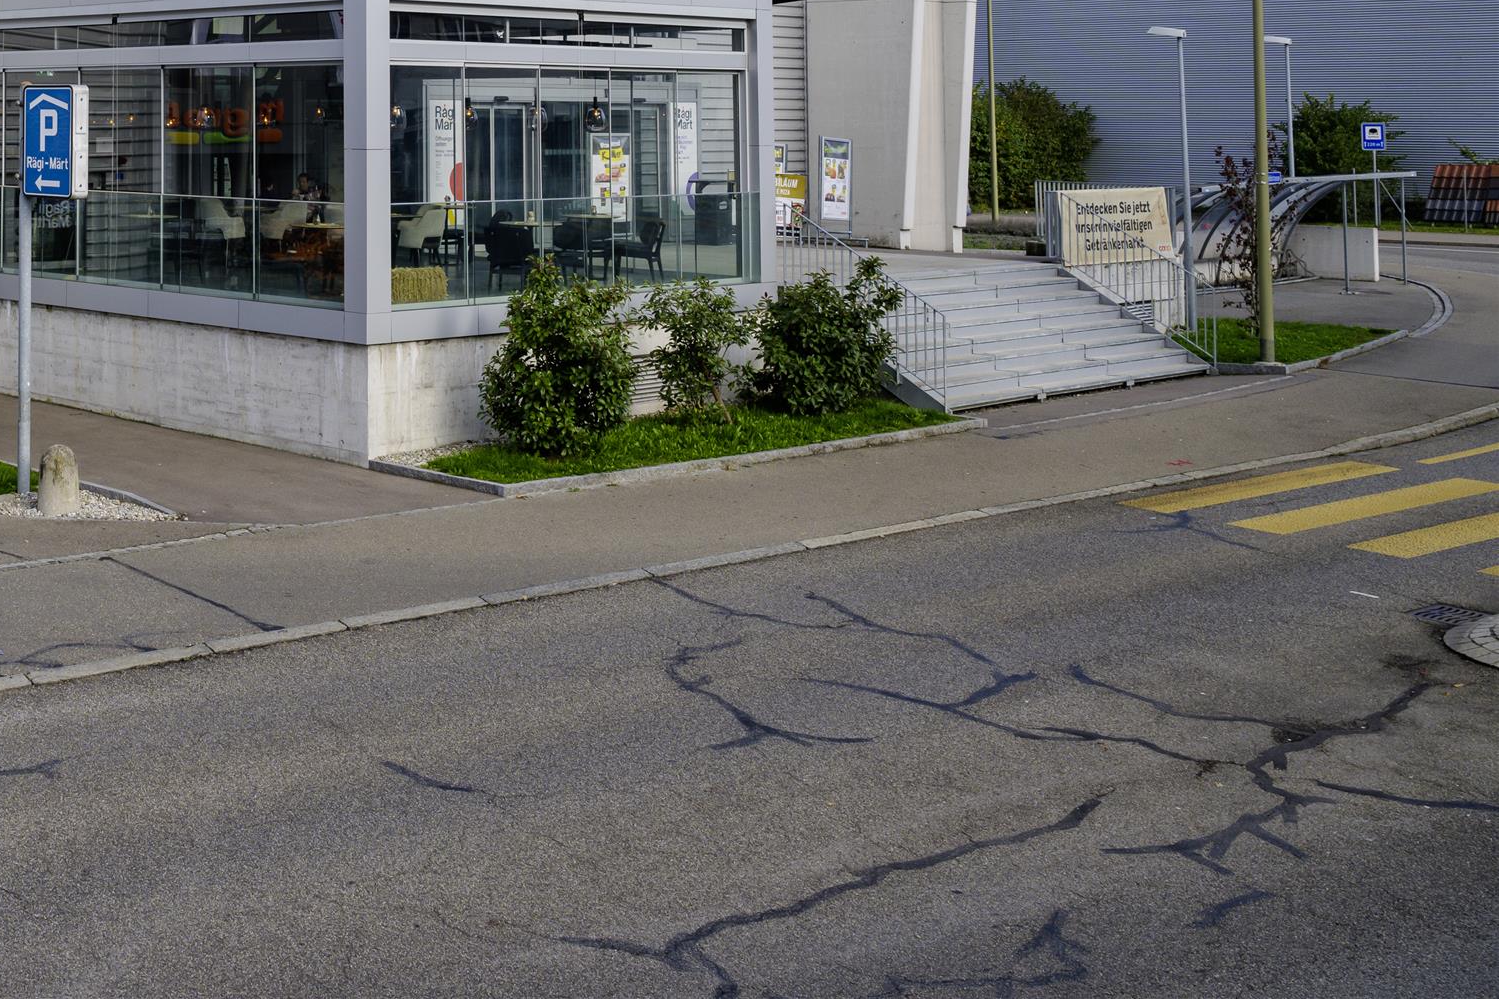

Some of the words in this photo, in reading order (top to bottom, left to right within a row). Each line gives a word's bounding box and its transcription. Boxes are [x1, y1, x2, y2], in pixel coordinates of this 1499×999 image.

[39, 108, 59, 152] P
[1076, 202, 1118, 215] Entdecken
[1119, 201, 1131, 214] Sie
[1132, 200, 1151, 216] jetzt
